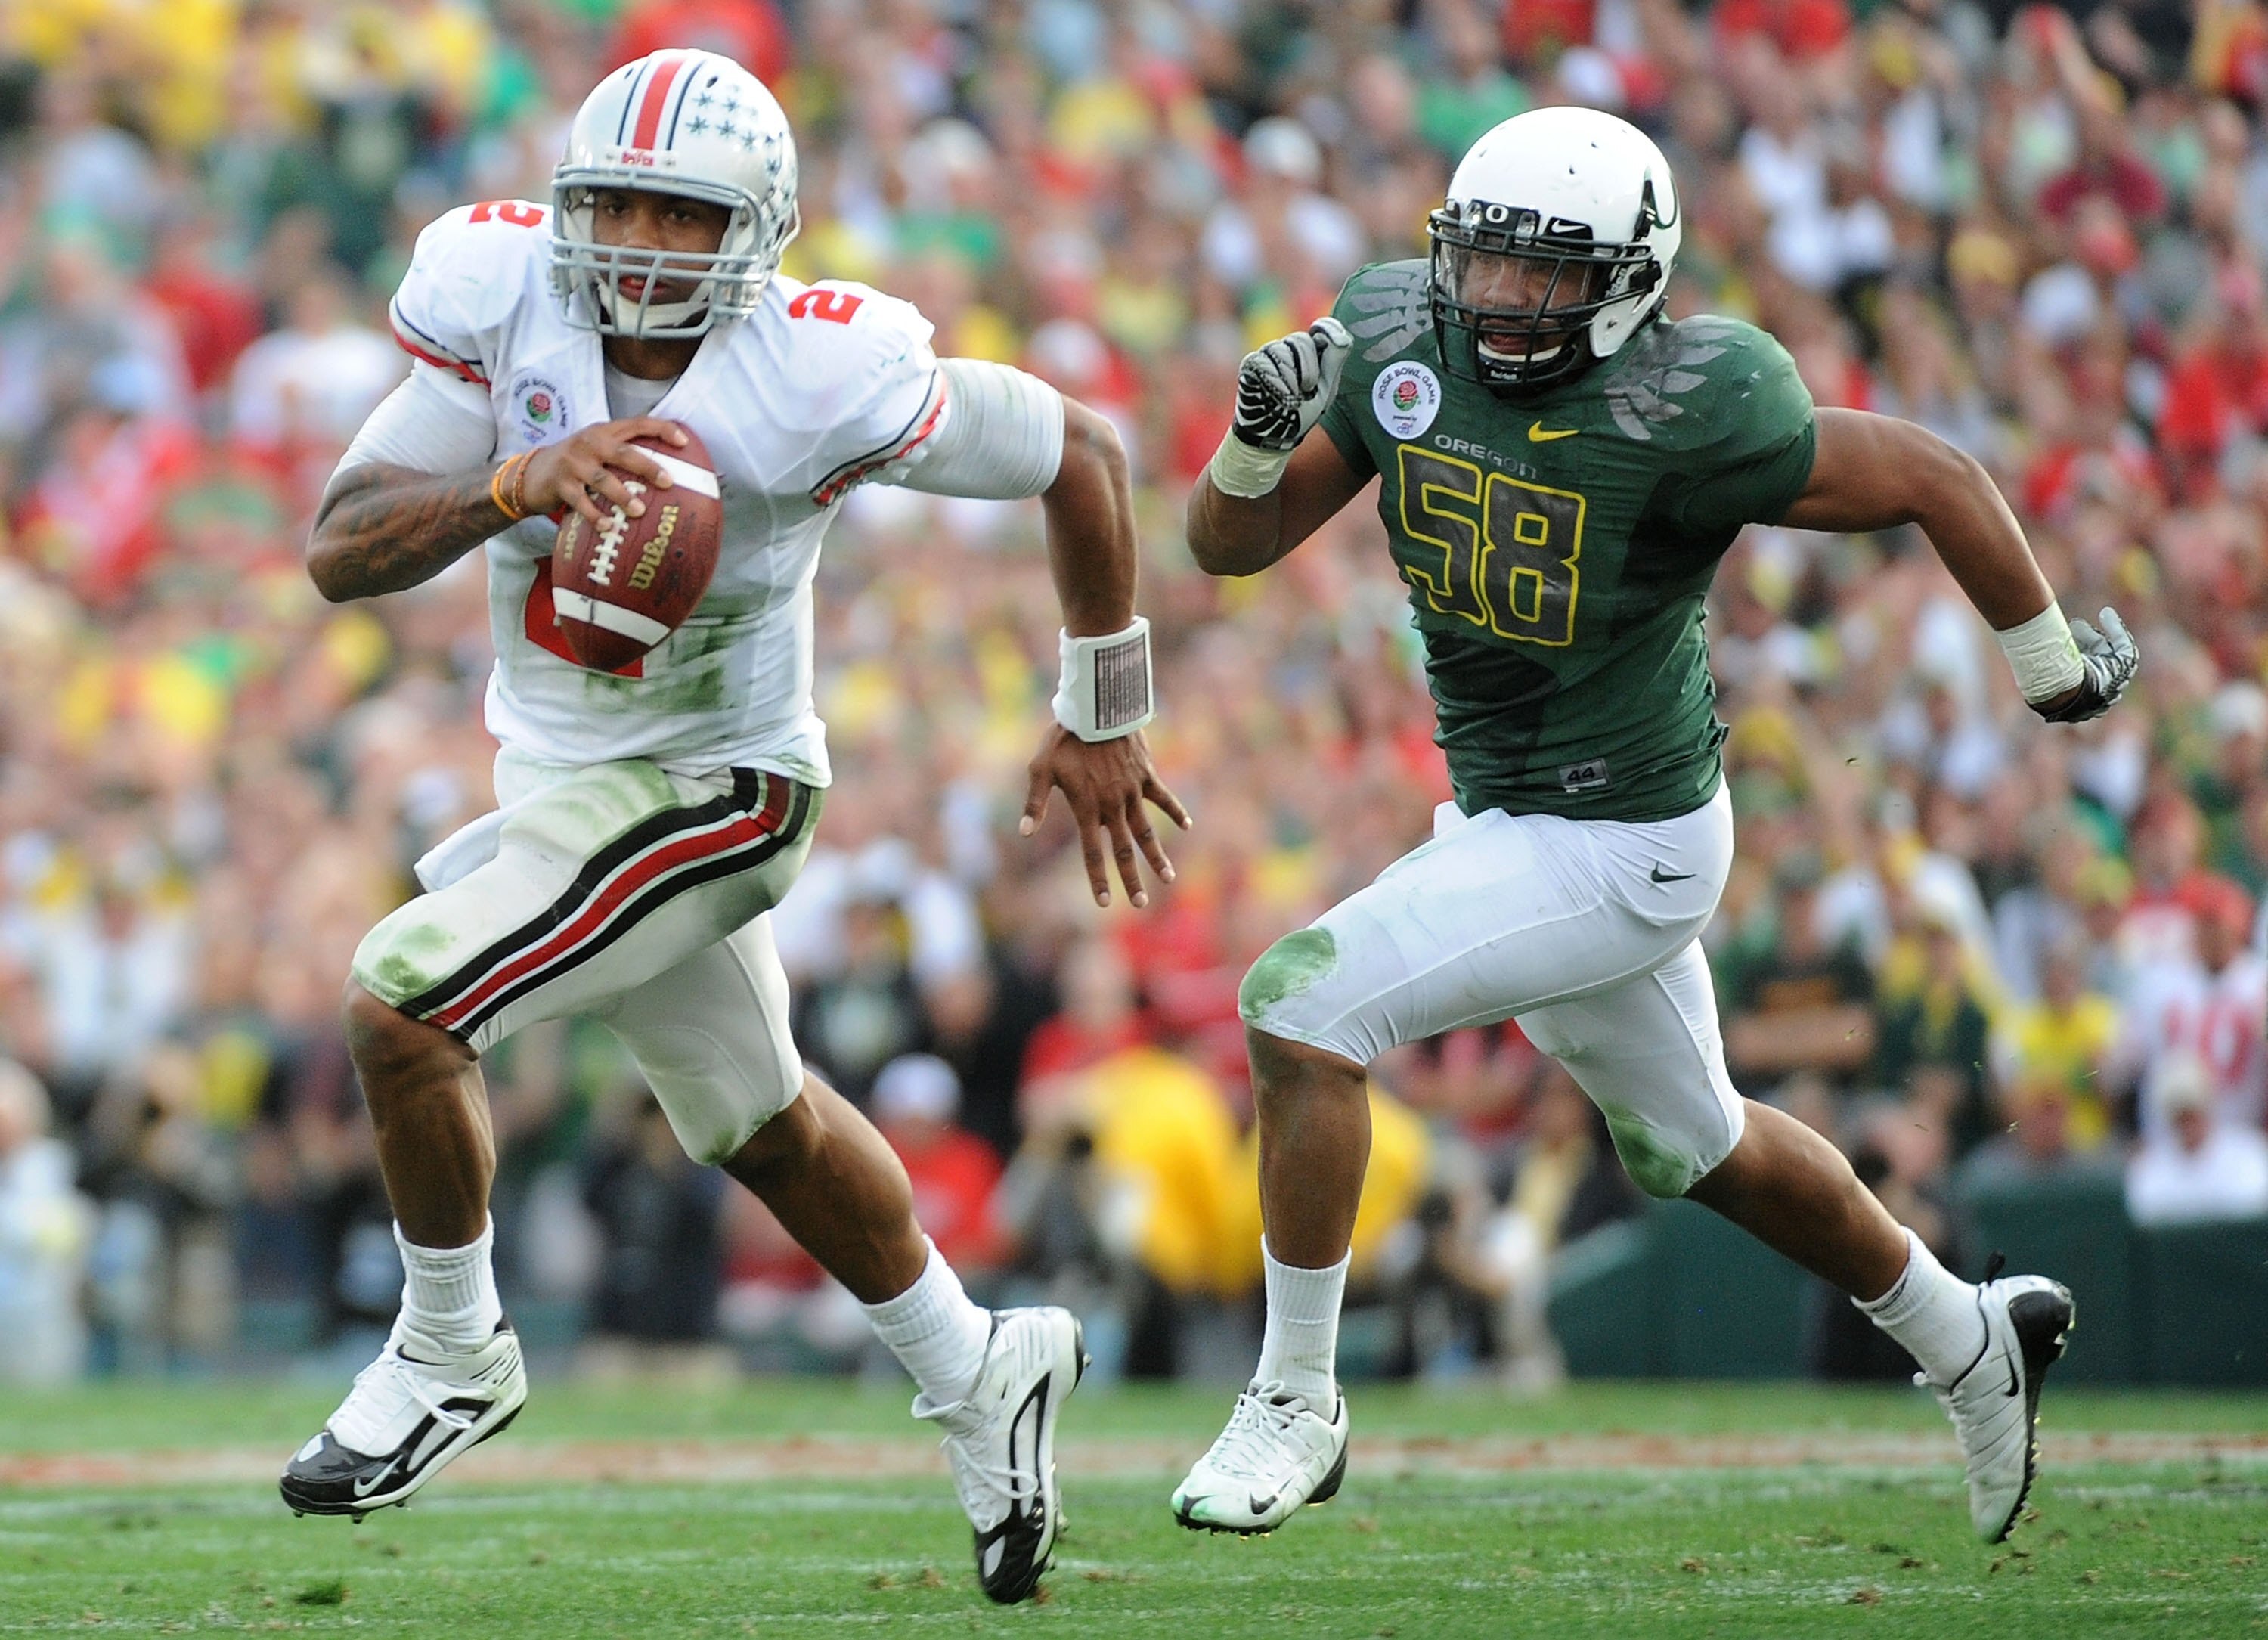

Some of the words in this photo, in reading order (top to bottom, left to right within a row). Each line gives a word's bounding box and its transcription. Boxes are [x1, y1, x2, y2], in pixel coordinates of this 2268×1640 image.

[469, 200, 544, 228] 2
[1486, 204, 1509, 223] O
[788, 290, 864, 325] 2
[1378, 373, 1394, 399] ROSE
[1394, 367, 1421, 379] BOWL
[1421, 375, 1436, 405] GAME
[1434, 434, 1537, 479] OREGON
[628, 505, 680, 590] Wilson
[1397, 443, 1586, 646] 58
[1567, 767, 1595, 781] 44
